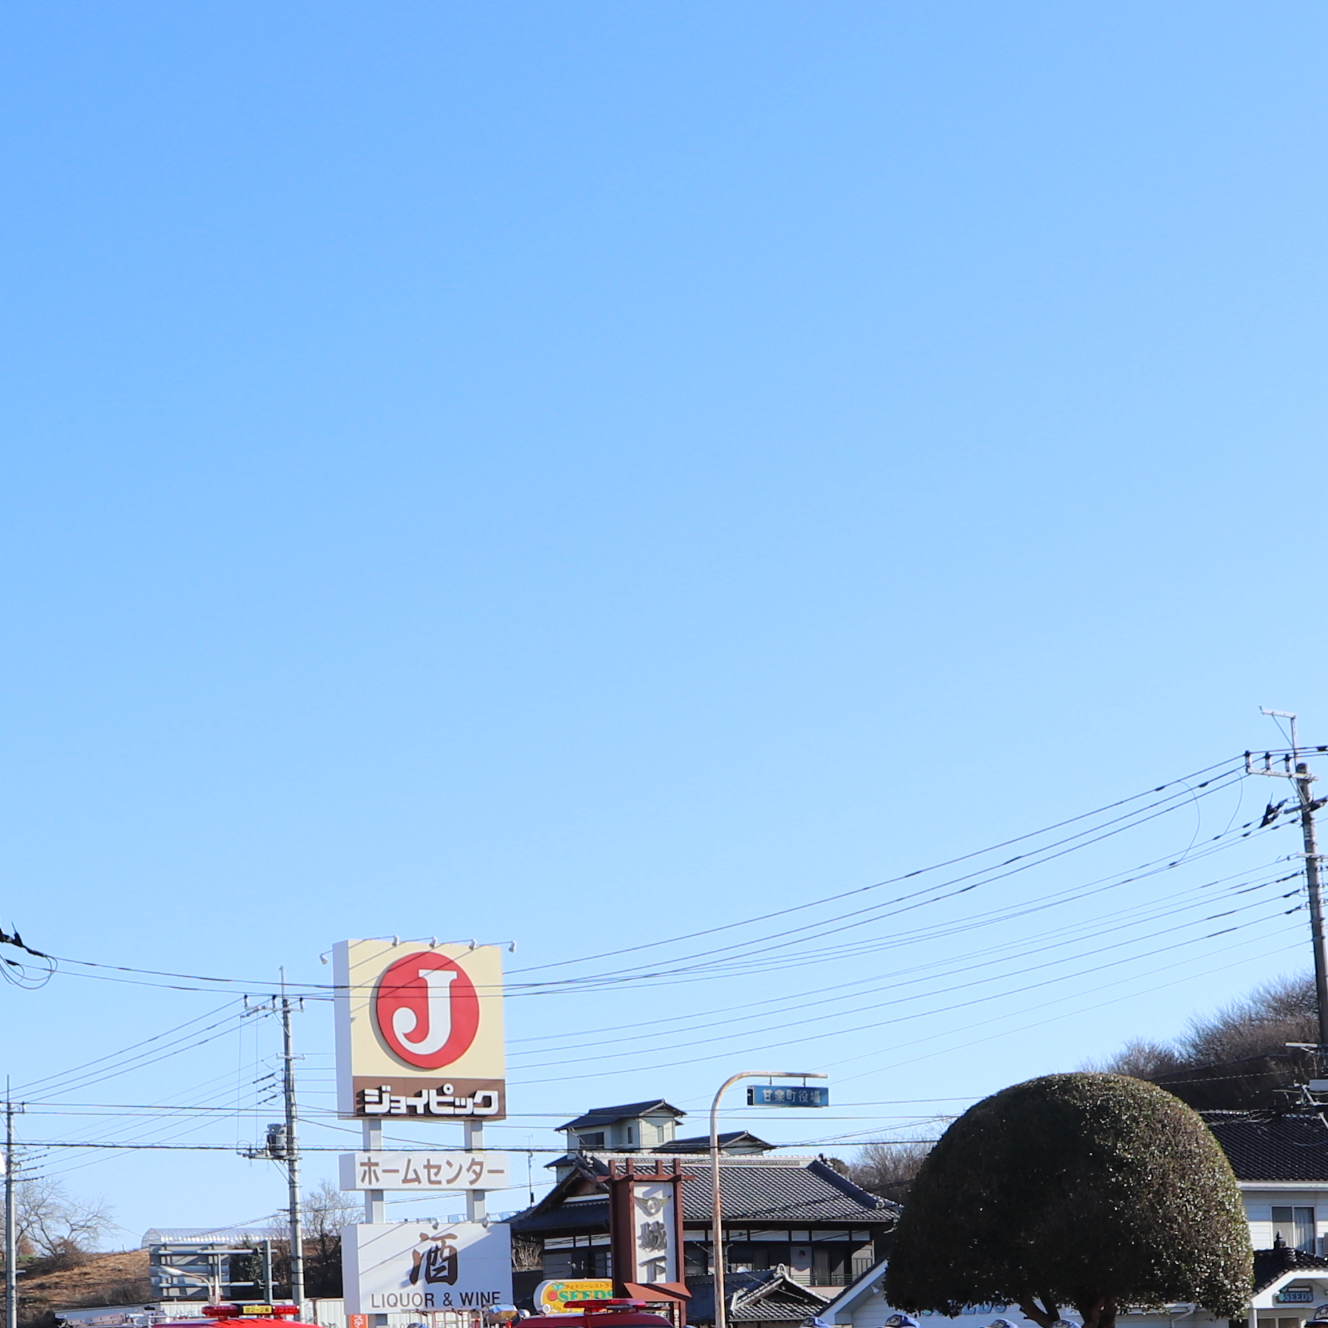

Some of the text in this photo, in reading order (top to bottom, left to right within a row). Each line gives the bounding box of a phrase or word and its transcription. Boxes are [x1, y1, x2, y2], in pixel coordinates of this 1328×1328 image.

[392, 969, 458, 1055] J
[364, 1083, 499, 1115] ジョイピック
[359, 1156, 505, 1186] ホームセンター
[409, 1233, 458, 1286] 酒
[371, 1291, 501, 1308] LIQUOR & WINE
[1285, 1292, 1314, 1302] SEEDS
